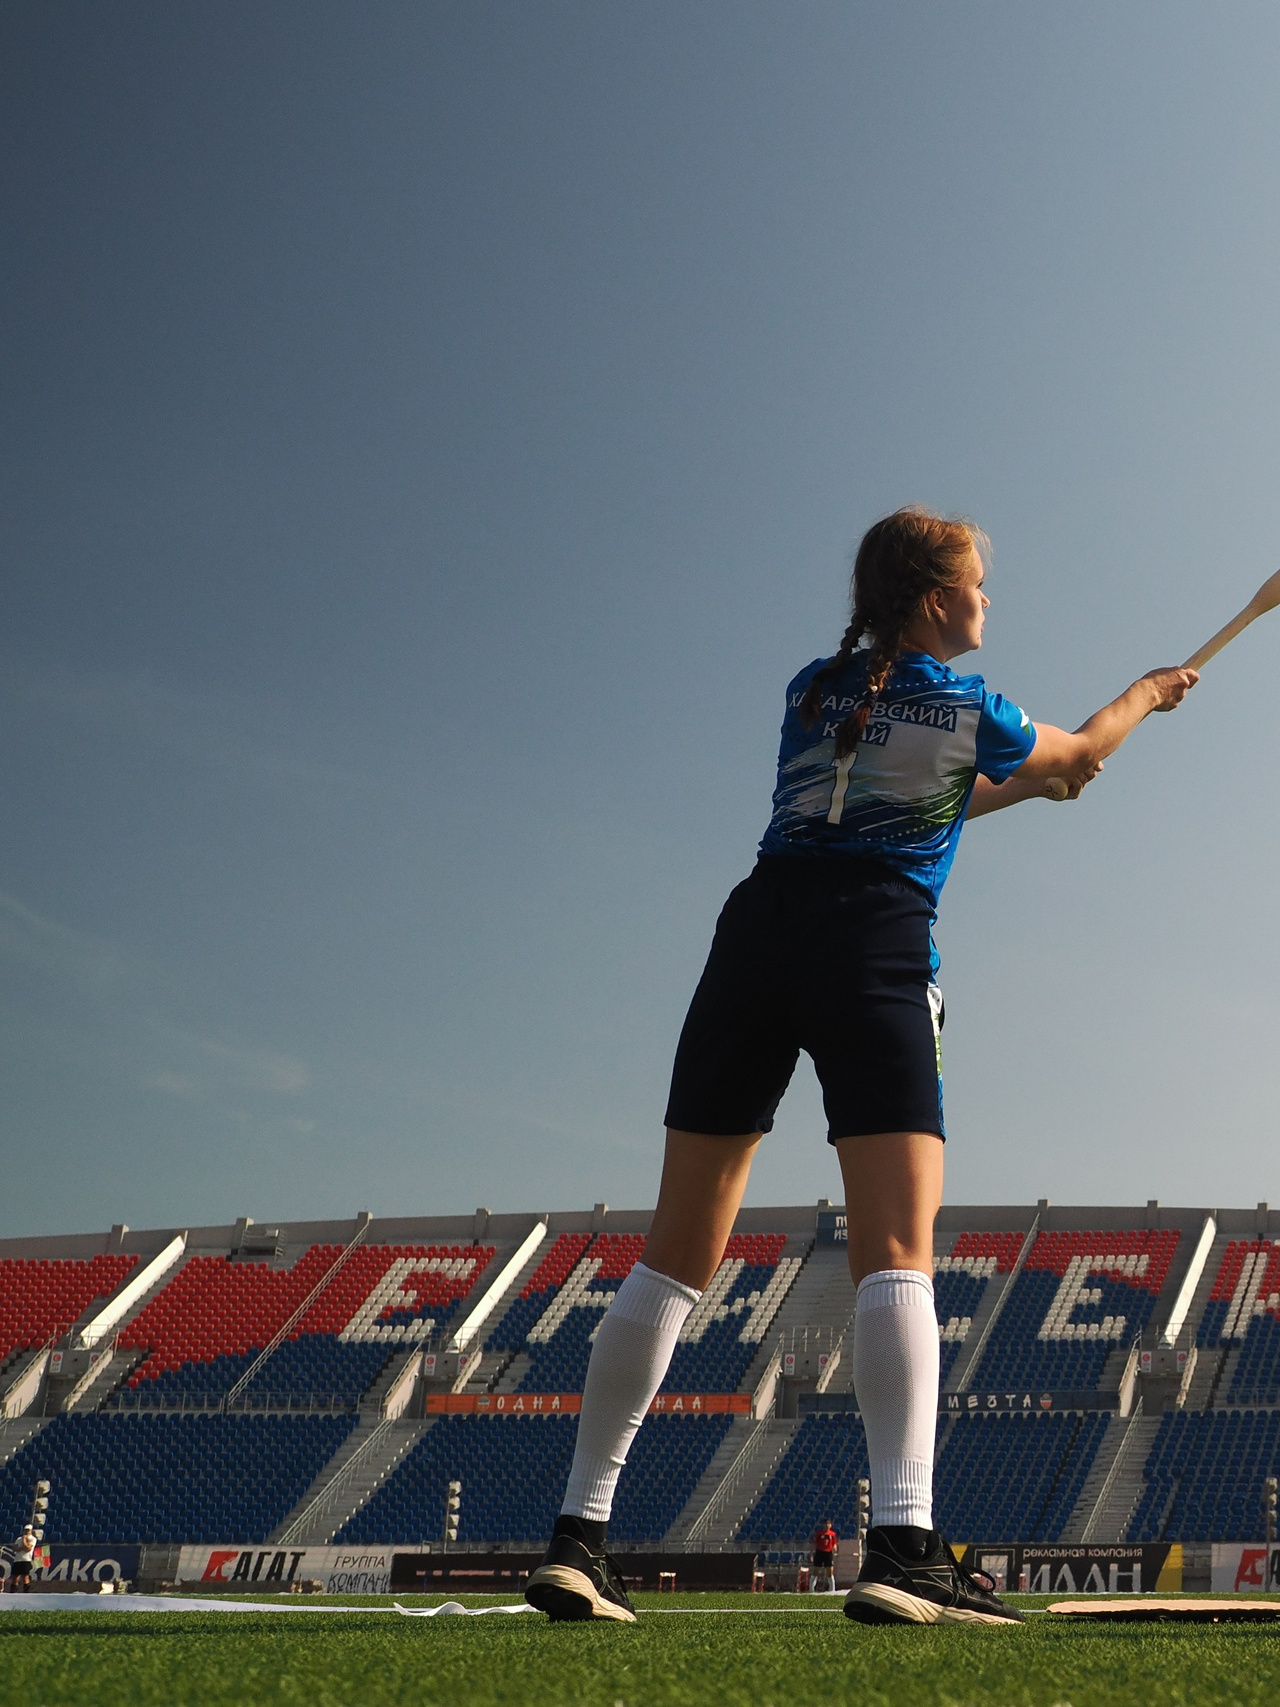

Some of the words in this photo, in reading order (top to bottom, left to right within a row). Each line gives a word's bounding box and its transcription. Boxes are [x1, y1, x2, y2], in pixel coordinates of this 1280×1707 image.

[788, 692, 956, 730] ХАРВСКИЙ
[822, 721, 888, 745] КЙ
[827, 752, 858, 825] 1
[496, 1395, 561, 1411] ОДНА
[334, 1555, 385, 1568] ГРУППА
[1022, 1548, 1086, 1560] рекламная
[1088, 1547, 1143, 1558] компания
[0, 1558, 121, 1582] ИКО
[231, 1551, 306, 1582] АГАТ
